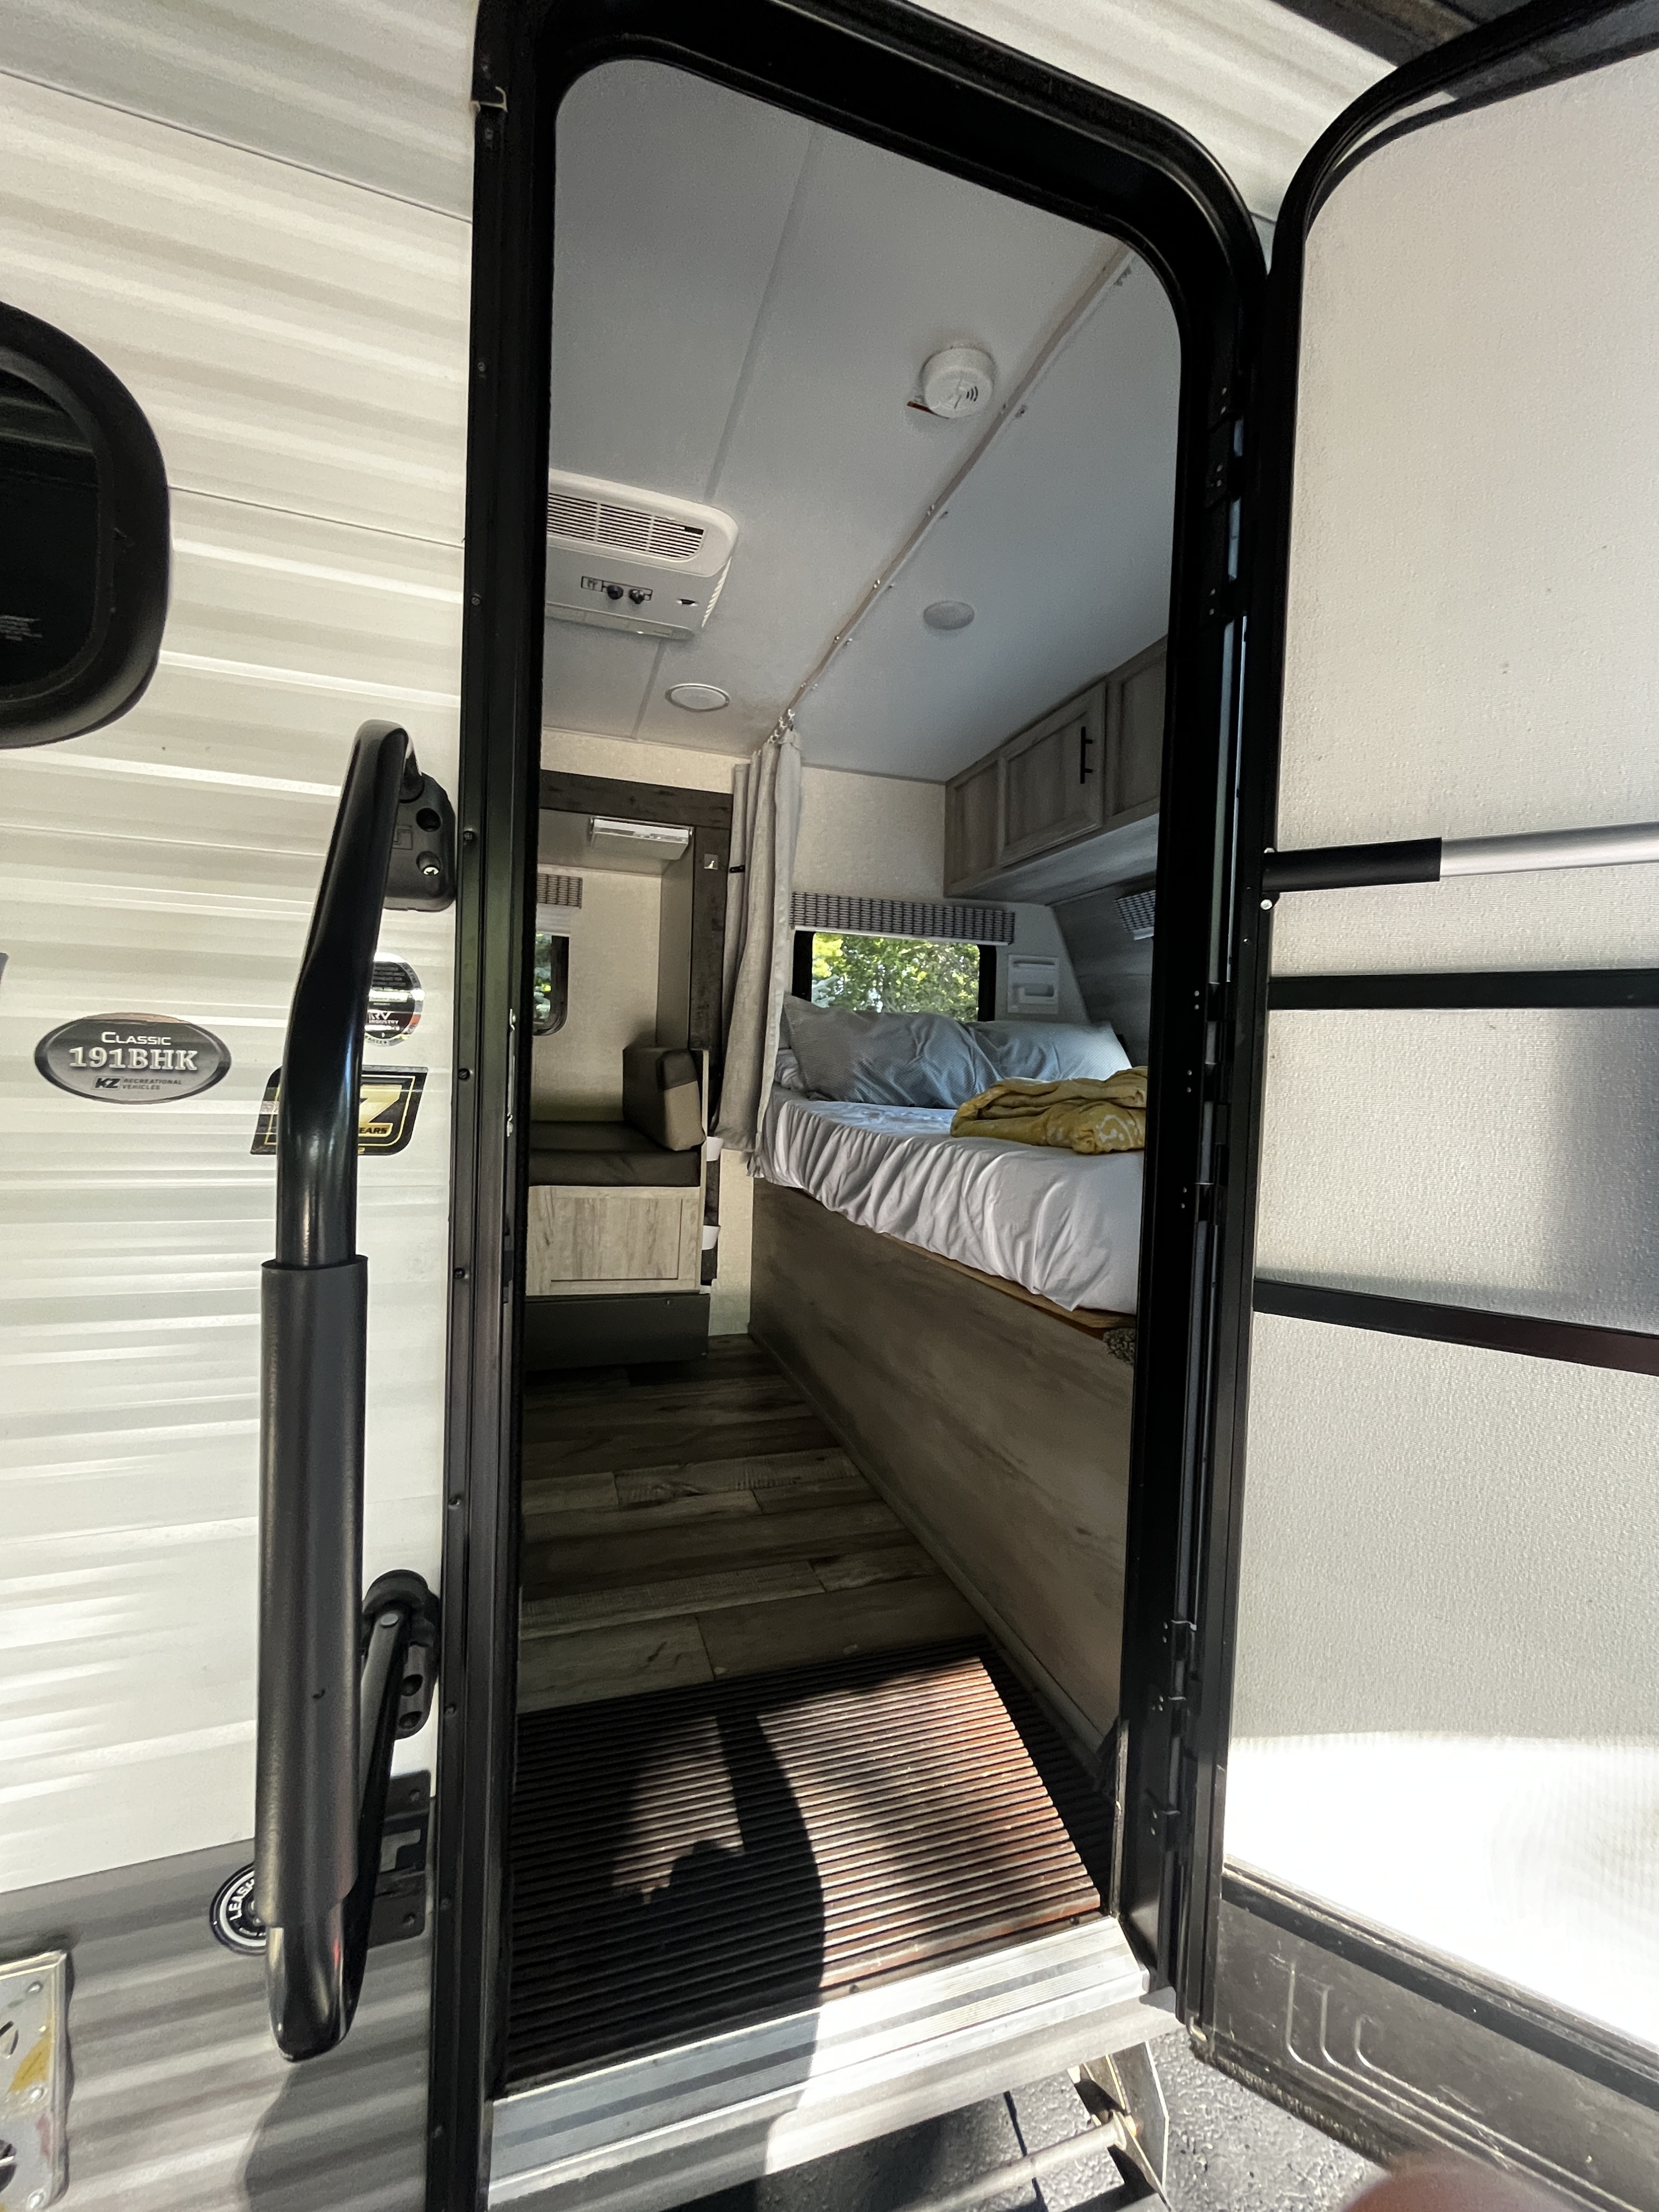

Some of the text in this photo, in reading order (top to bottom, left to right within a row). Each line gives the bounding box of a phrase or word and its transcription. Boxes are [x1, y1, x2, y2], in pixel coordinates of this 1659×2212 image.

[101, 1031, 171, 1045] CLASSIC
[69, 1046, 198, 1071] 191BHK
[95, 1078, 121, 1088] KZ
